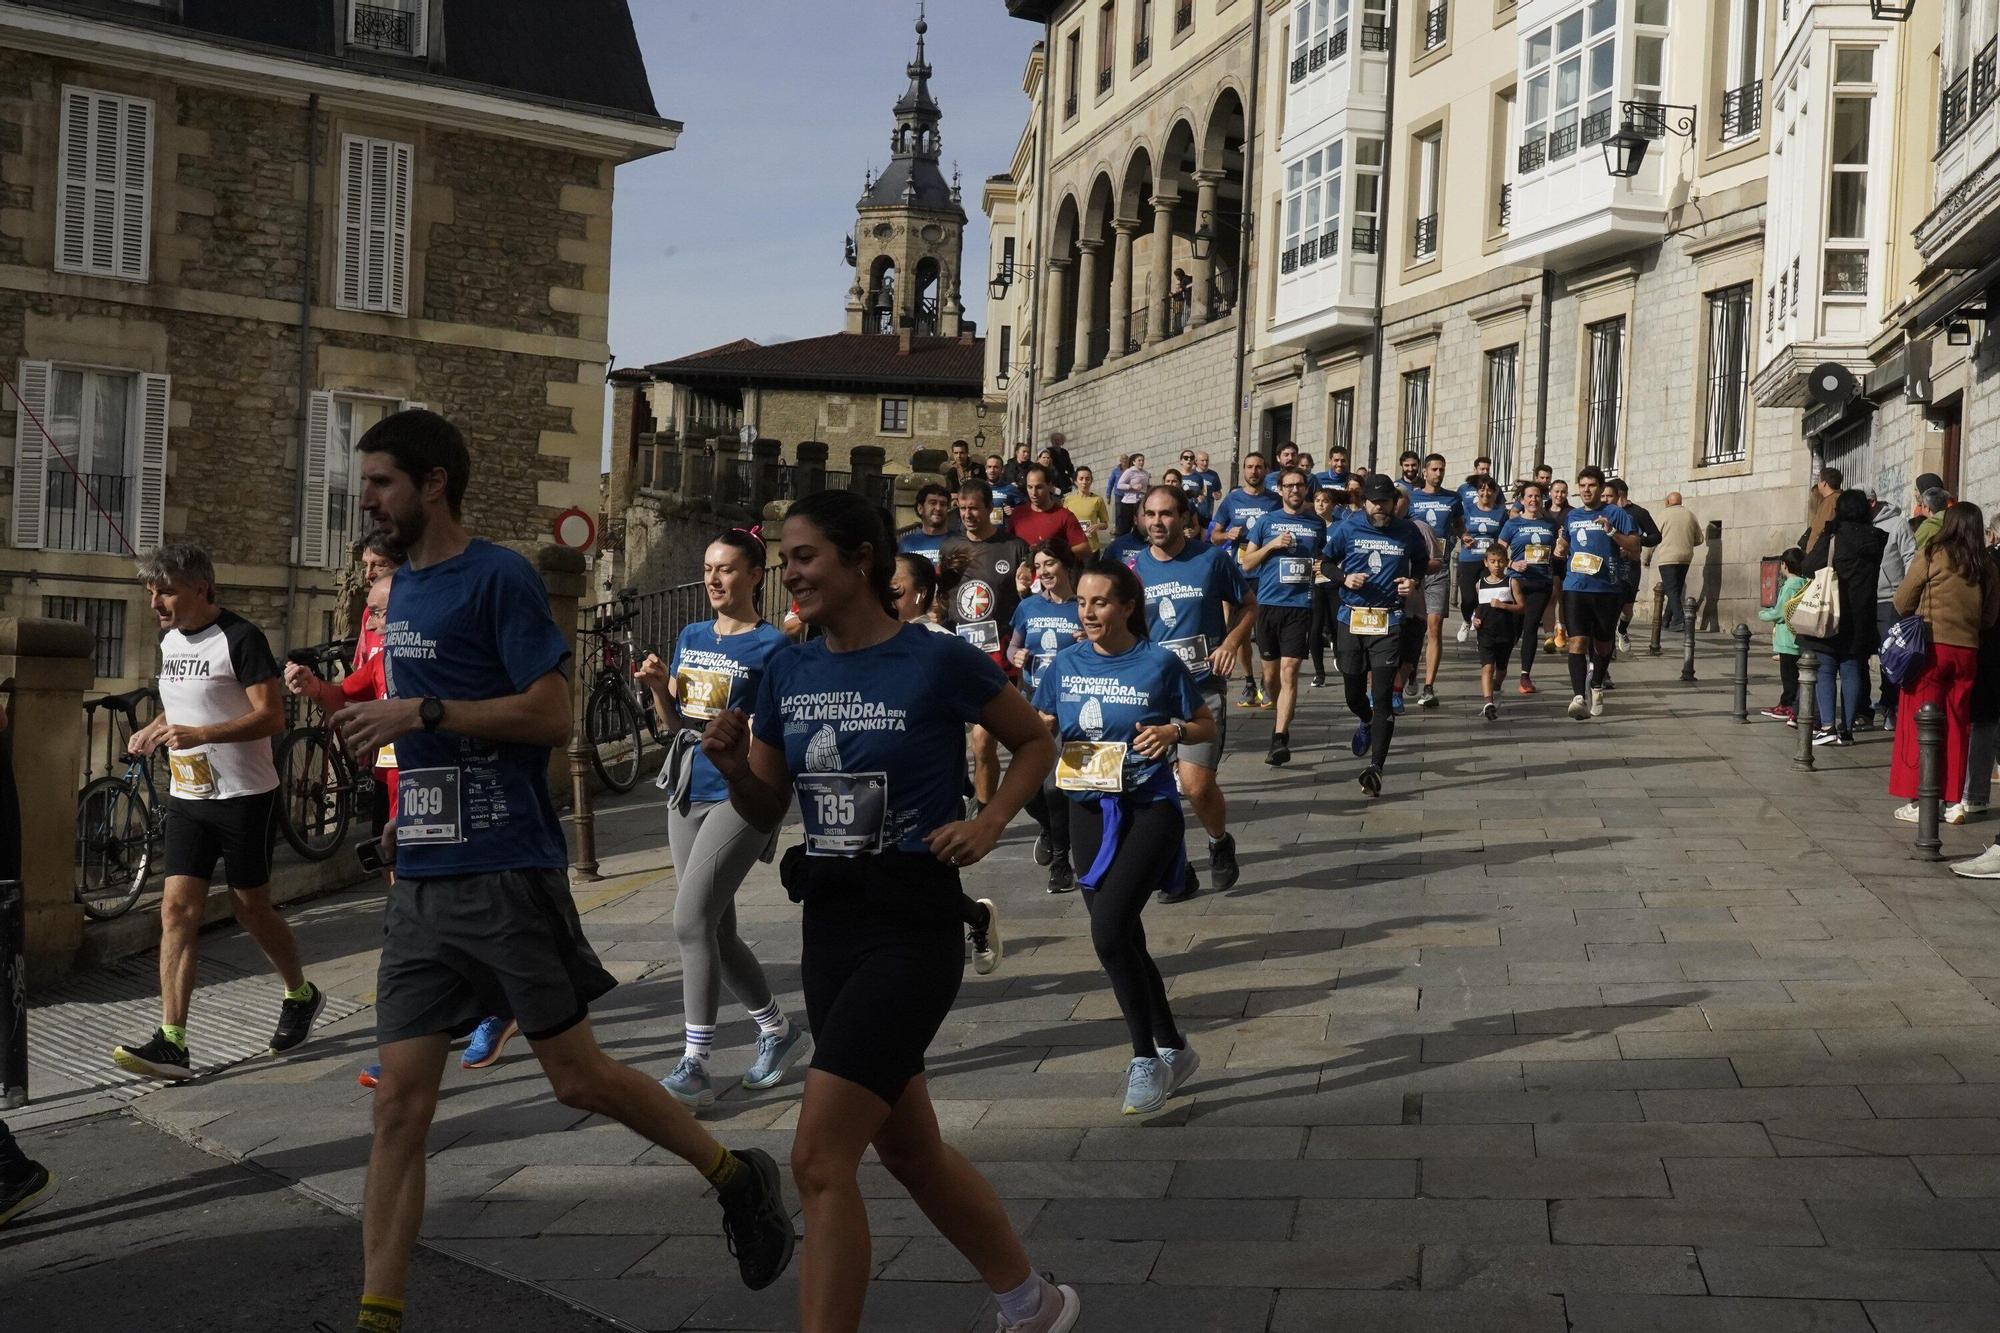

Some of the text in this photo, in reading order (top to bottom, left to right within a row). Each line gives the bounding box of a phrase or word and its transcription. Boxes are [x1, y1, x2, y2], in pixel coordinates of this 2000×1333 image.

[1289, 564, 1305, 574] 878
[1144, 581, 1180, 593] CONQUISTA
[1146, 585, 1194, 599] ALMENDRA
[1033, 622, 1079, 630] ALMENDRA
[383, 632, 437, 648] LMENDRA REN
[393, 647, 437, 660] KONKISTA
[686, 649, 727, 660] CONQUISTA
[682, 655, 739, 670] ALMENDRA
[1070, 676, 1120, 686] CONQUISTA
[1069, 685, 1137, 697] ALMENDRA
[781, 691, 862, 707] LA CONQUISTA
[1102, 696, 1149, 707] KONKISTA
[793, 702, 887, 721] ALMENDRA
[887, 709, 907, 719] REN
[840, 719, 906, 732] KONKISTA
[446, 774, 456, 783] 5K
[403, 787, 443, 817] 1039
[813, 794, 855, 825] 135
[824, 828, 847, 836] CRISTINA
